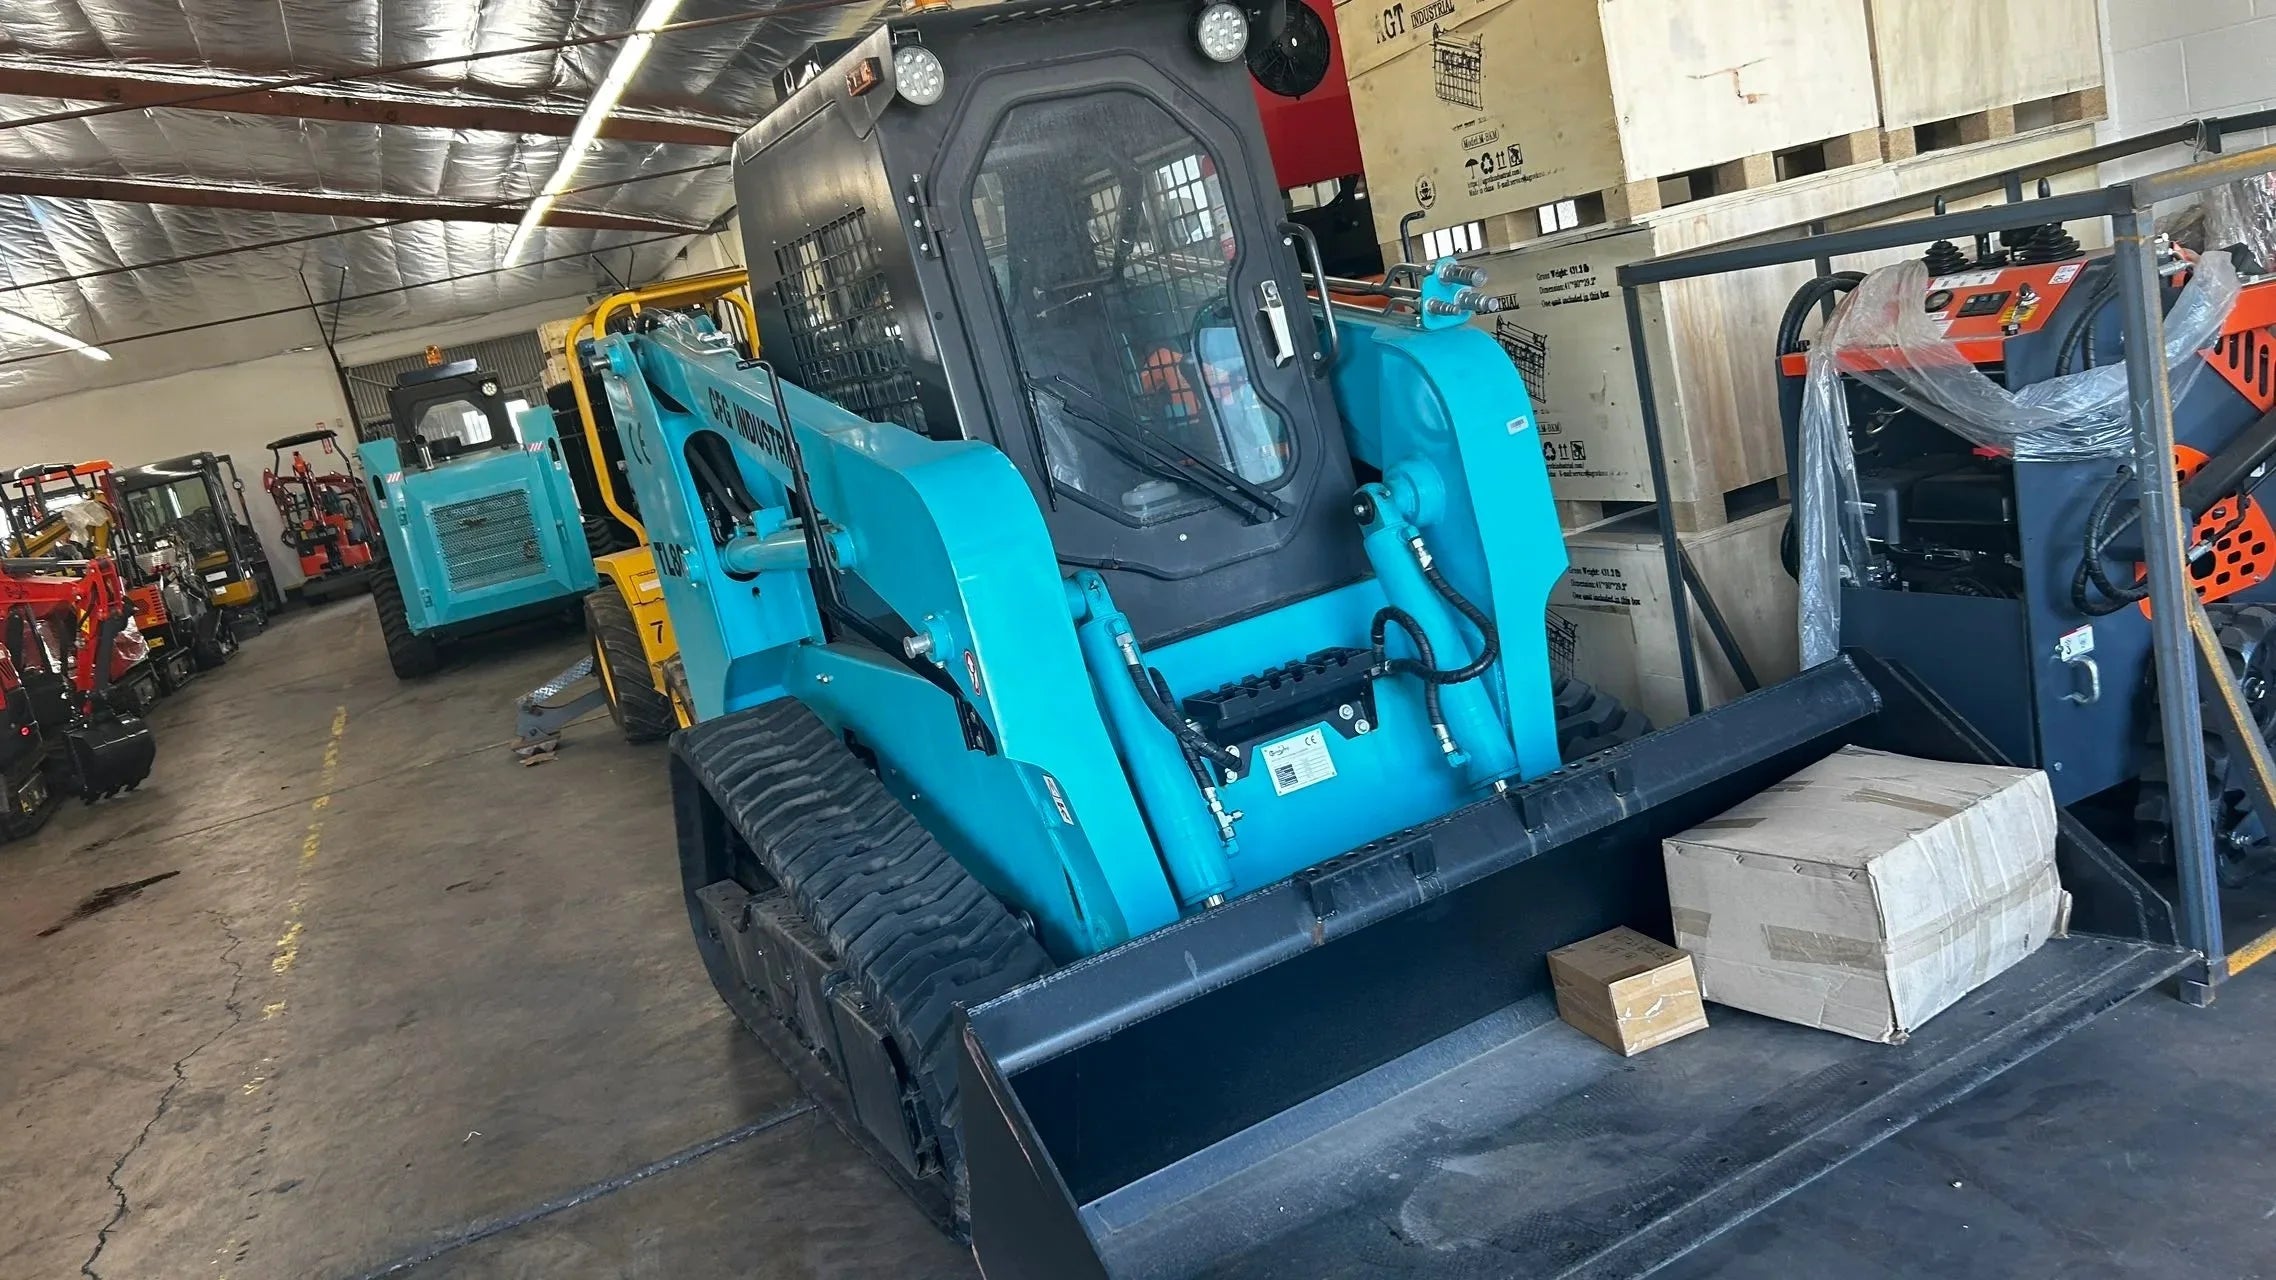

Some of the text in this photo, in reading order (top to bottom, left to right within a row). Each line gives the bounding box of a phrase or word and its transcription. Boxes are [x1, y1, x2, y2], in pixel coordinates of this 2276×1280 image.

[1375, 0, 1455, 44] AGT INDUSTRIAL
[1536, 272, 1550, 281] Gross
[1563, 293, 1583, 304] included
[1590, 291, 1600, 301] this
[1600, 289, 1610, 298] box
[708, 386, 734, 430] CFG
[1621, 596, 1631, 605] this
[1631, 597, 1641, 605] box
[650, 621, 663, 644] 7
[1305, 734, 1317, 746] CE
